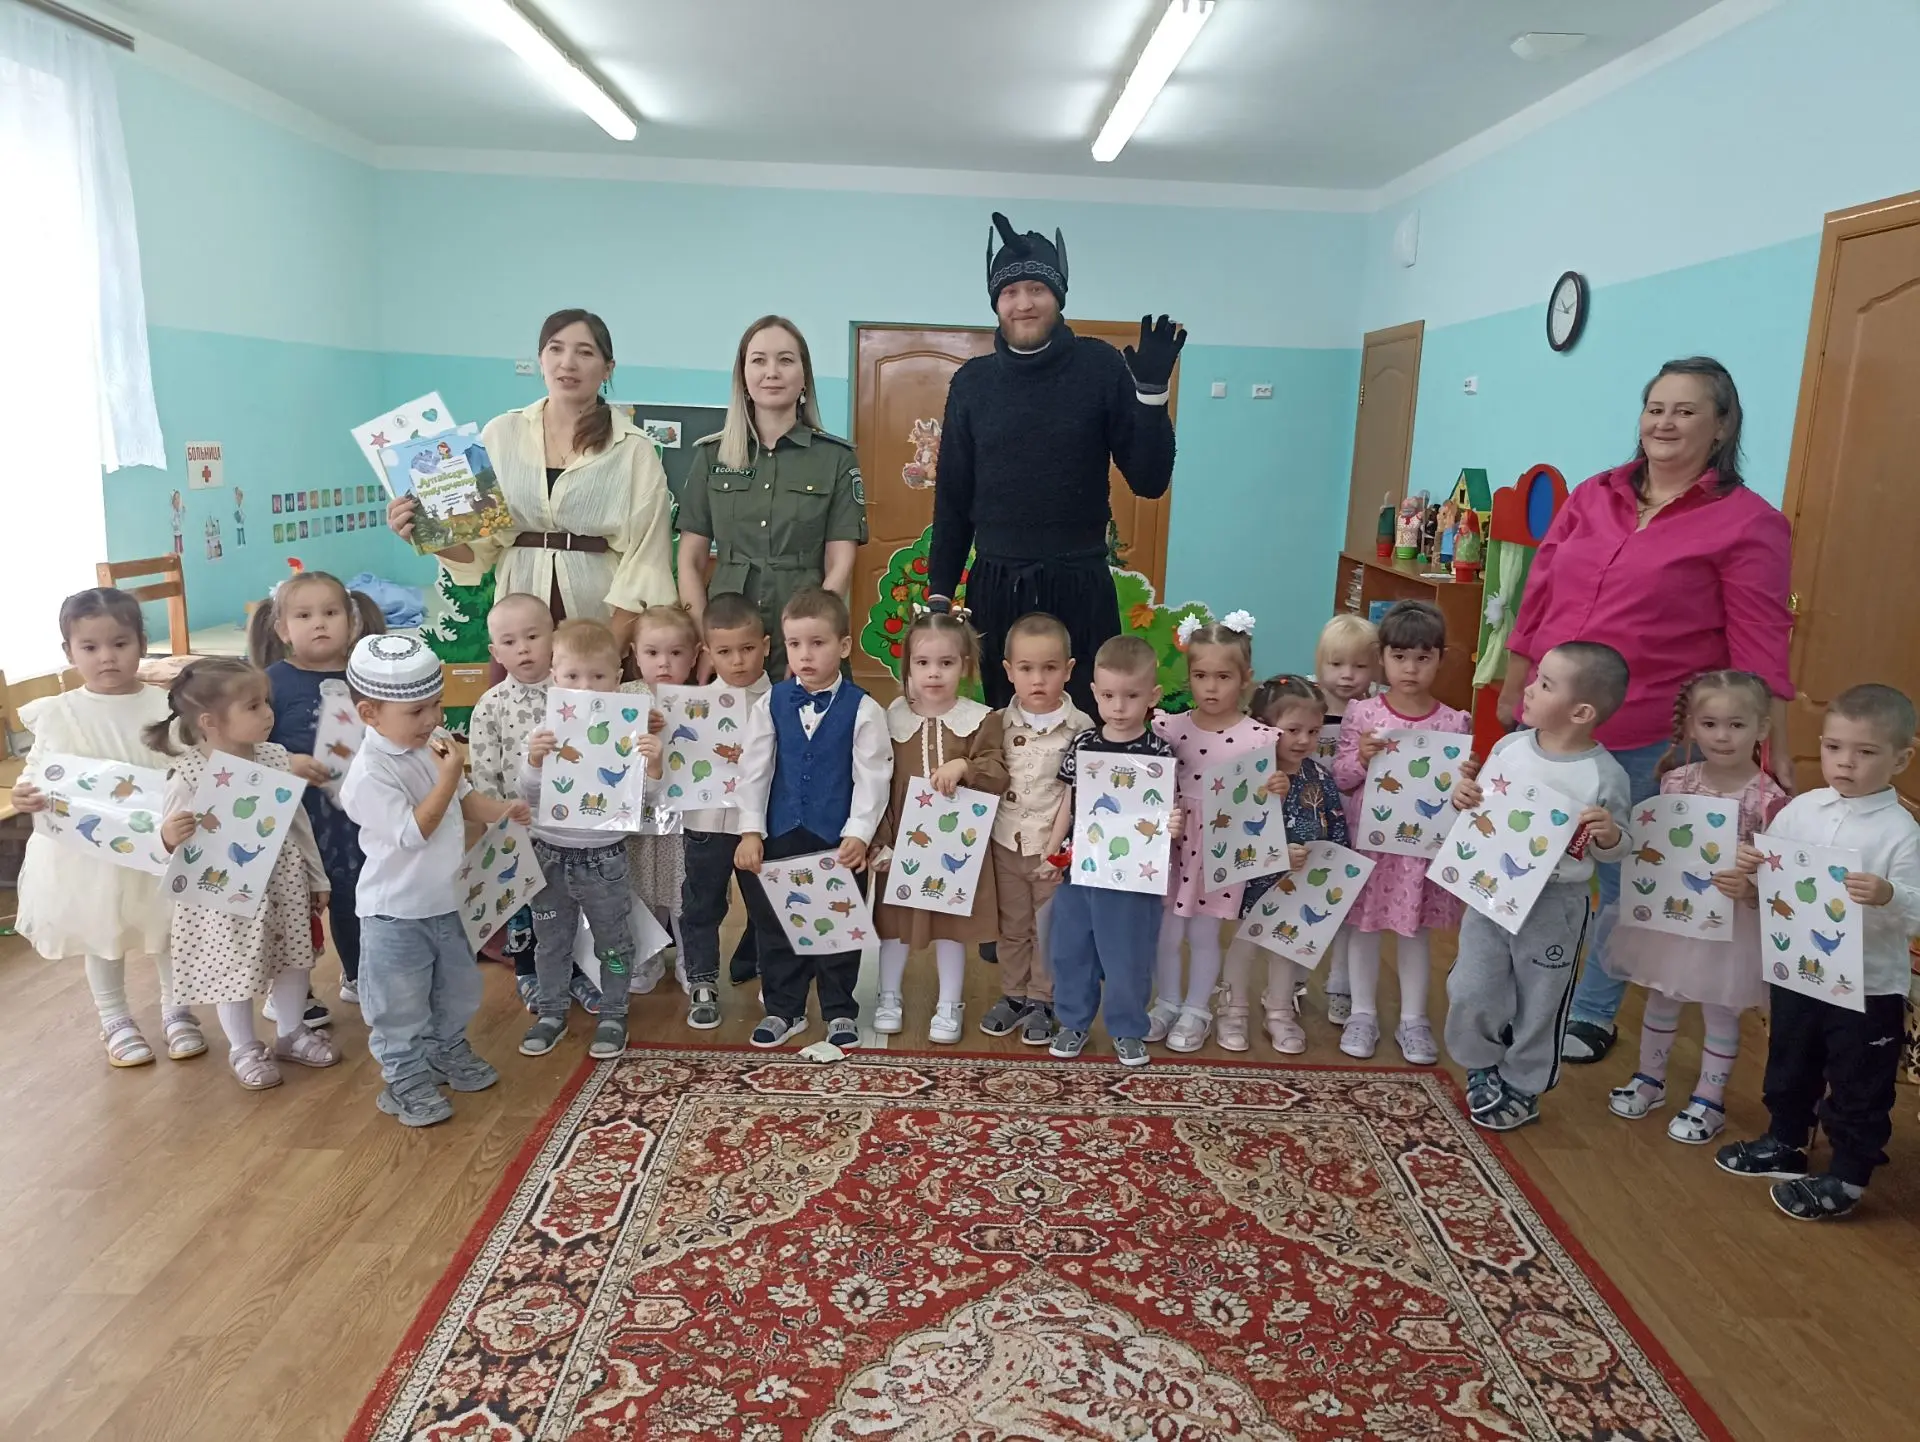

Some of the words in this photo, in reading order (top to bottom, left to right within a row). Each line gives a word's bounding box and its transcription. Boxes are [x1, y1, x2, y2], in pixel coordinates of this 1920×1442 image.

[187, 446, 221, 461] БОЛЬНИЦА
[715, 466, 751, 476] ECOLOGY
[532, 910, 557, 921] ROAR
